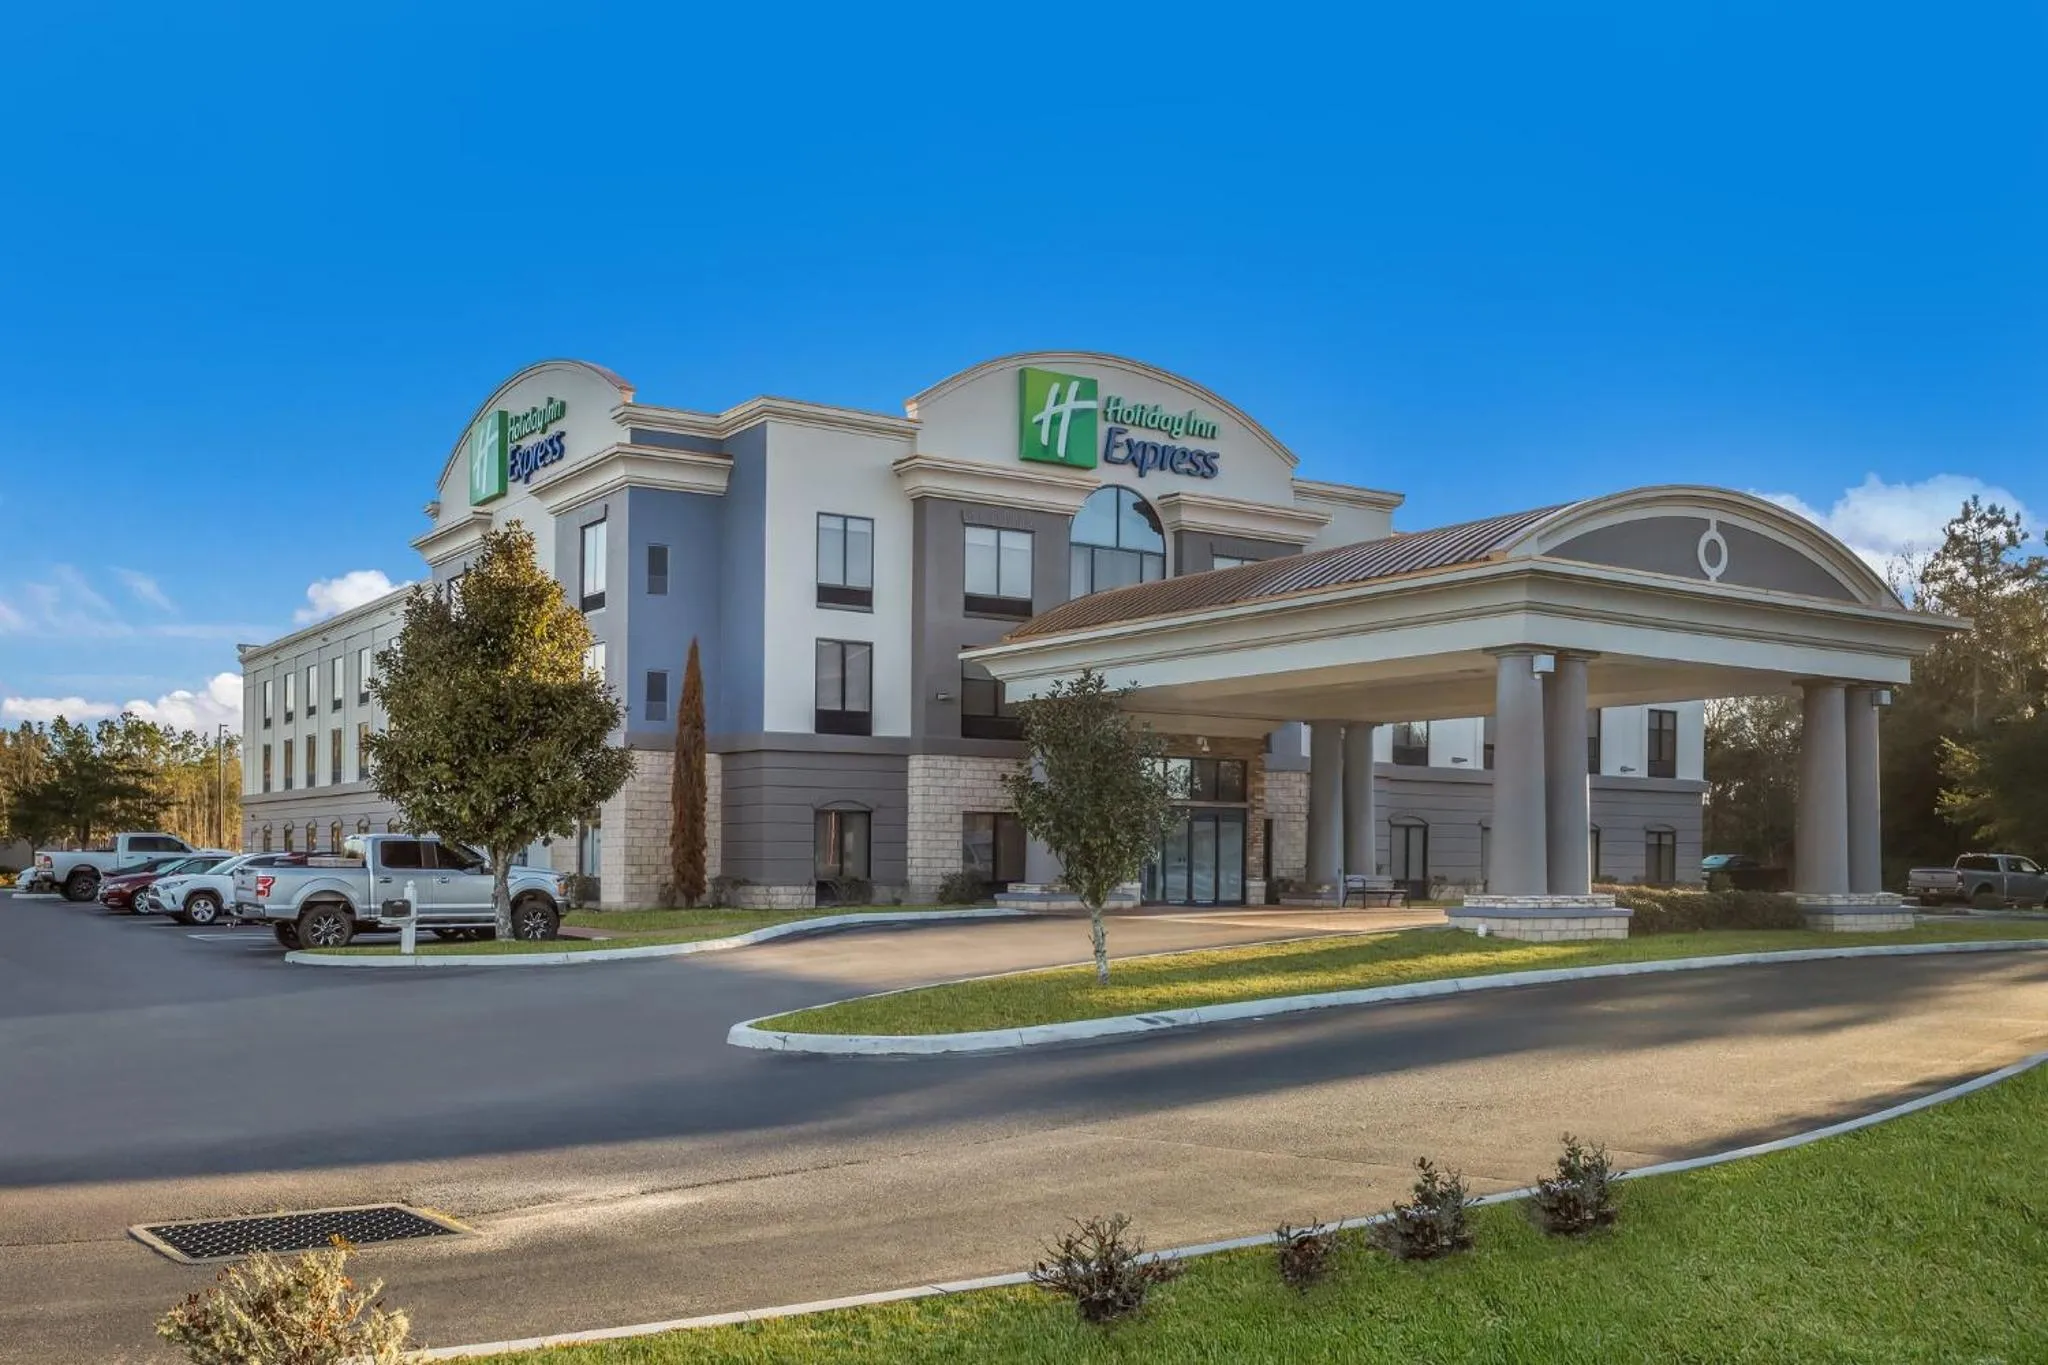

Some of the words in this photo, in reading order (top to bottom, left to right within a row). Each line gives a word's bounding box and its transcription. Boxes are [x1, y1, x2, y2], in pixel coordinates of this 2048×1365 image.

[508, 406, 548, 444] Holiday
[546, 396, 567, 425] Inn
[1032, 381, 1098, 458] H
[1103, 395, 1185, 440] Holiday
[1185, 408, 1220, 440] Inn
[472, 419, 499, 494] H
[508, 430, 567, 484] Express
[1103, 427, 1220, 479] Express
